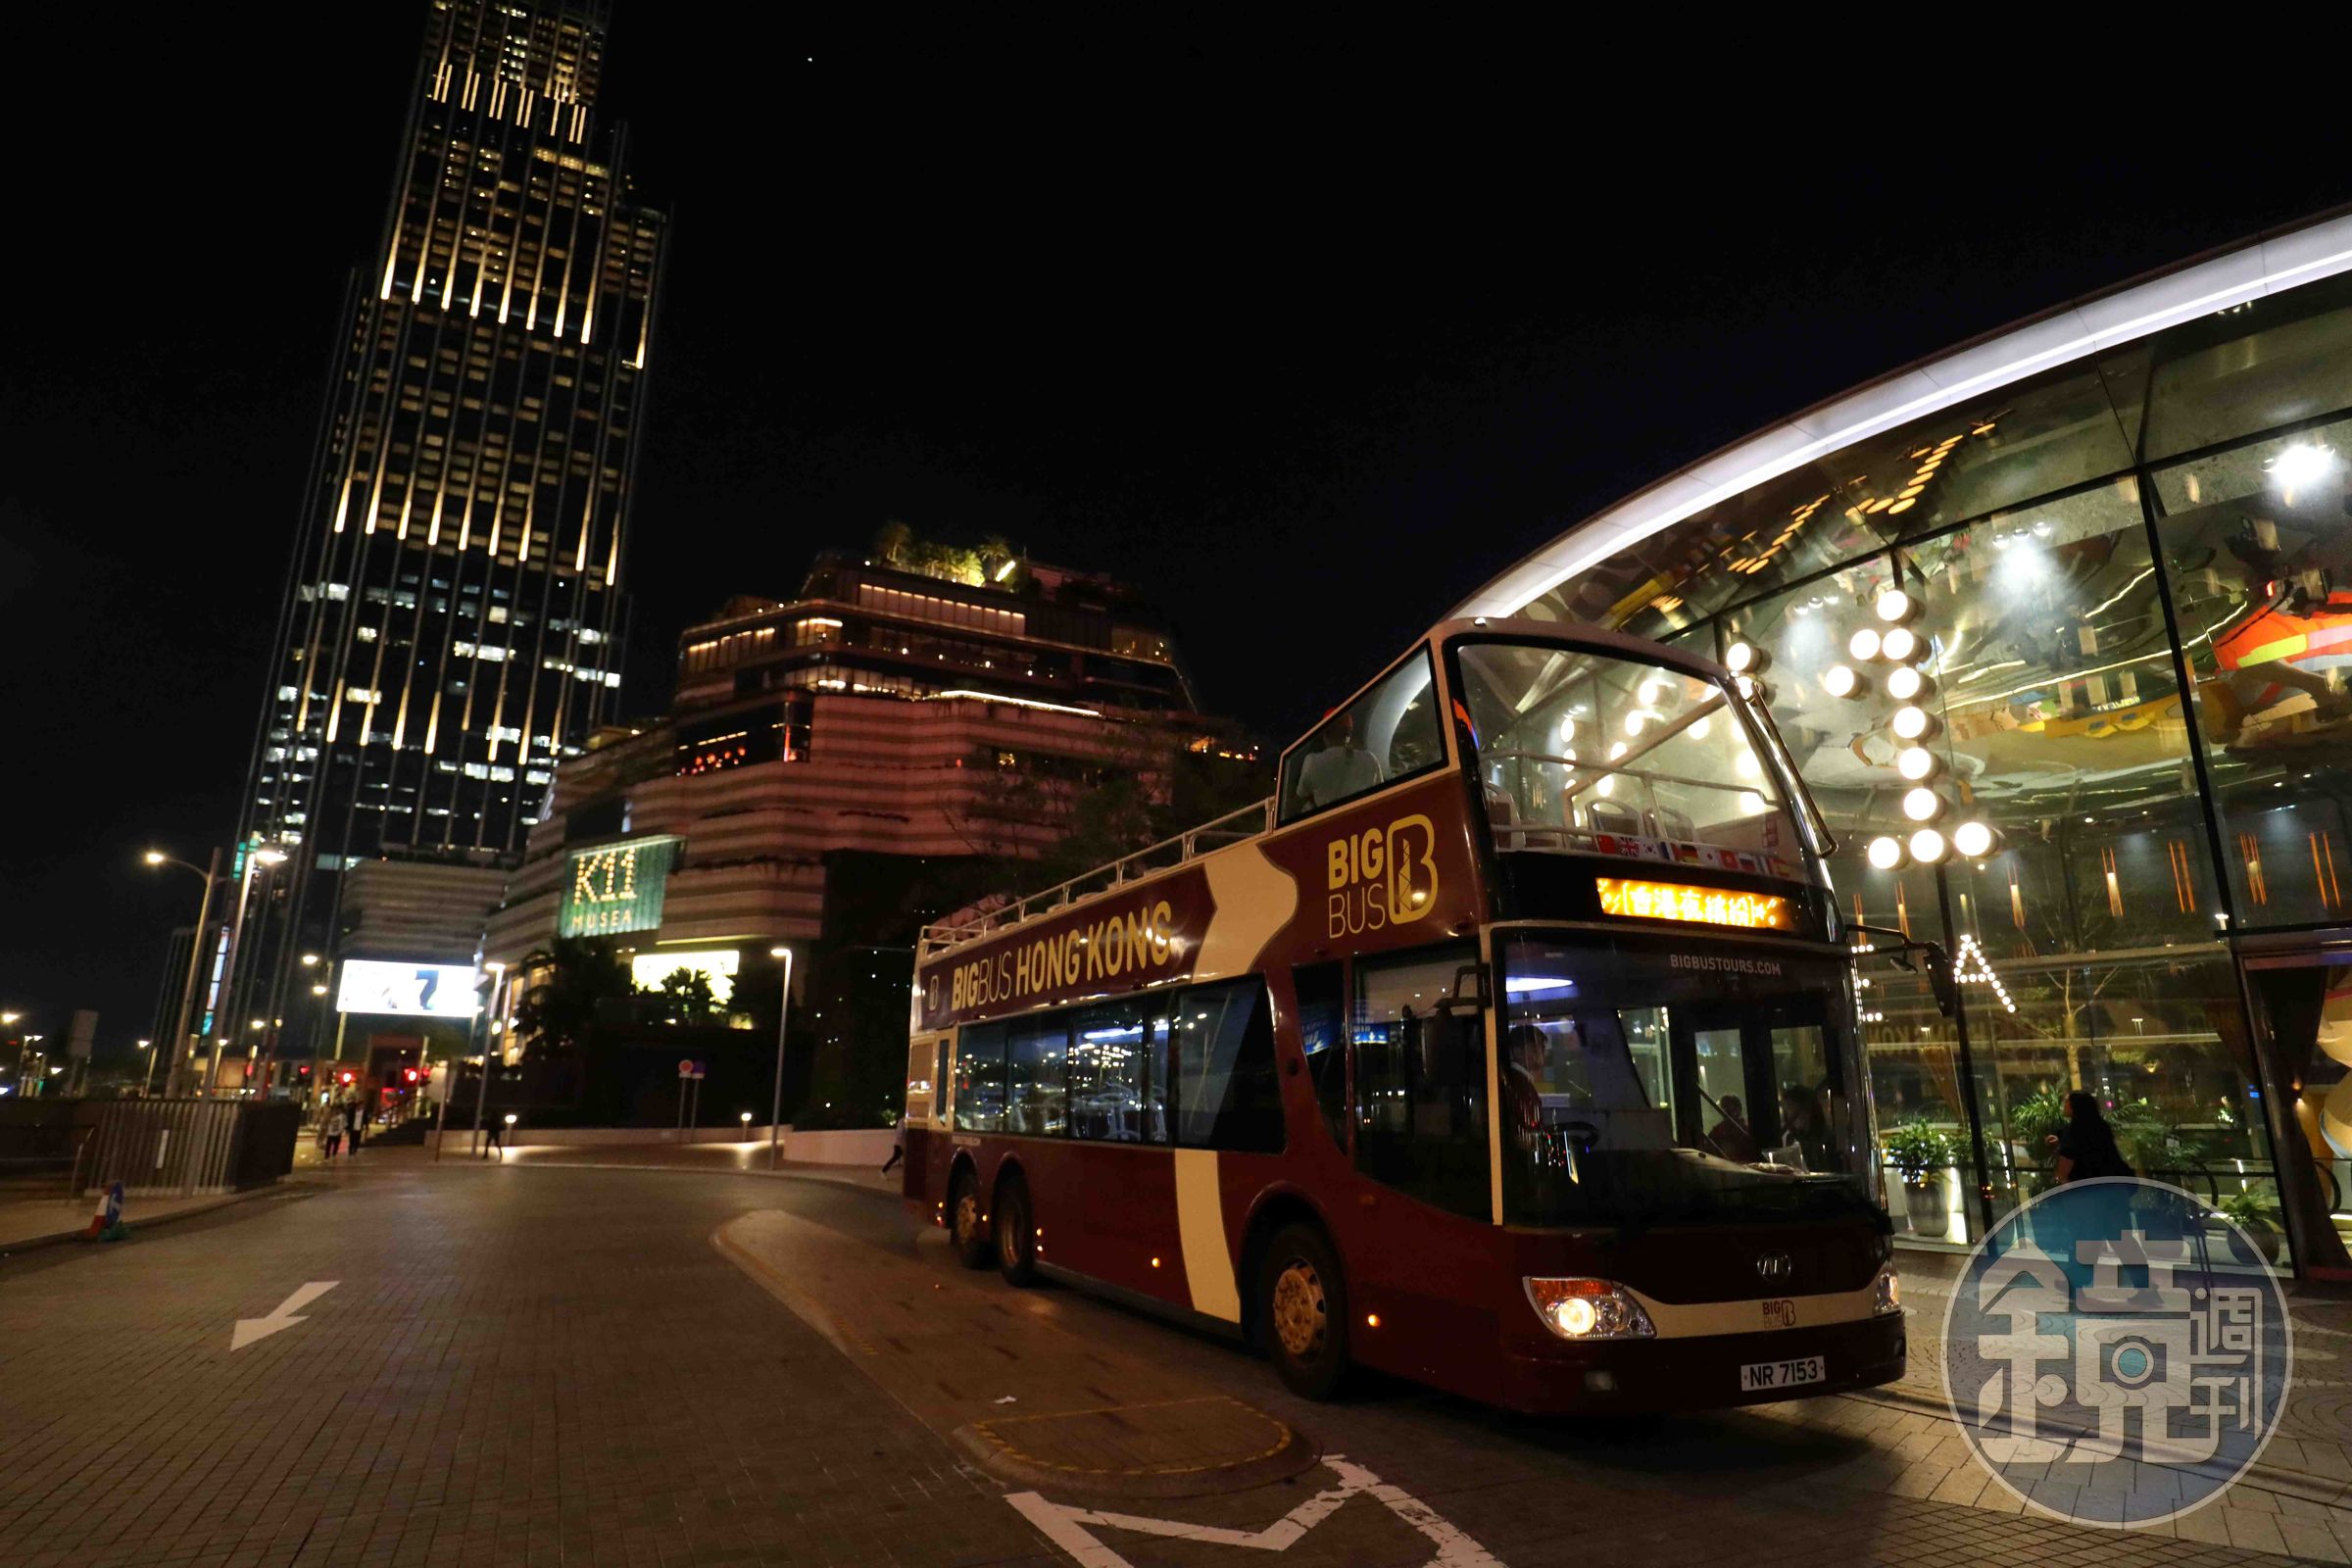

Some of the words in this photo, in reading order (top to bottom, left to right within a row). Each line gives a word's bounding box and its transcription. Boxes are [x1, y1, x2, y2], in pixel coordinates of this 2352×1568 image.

[1328, 827, 1384, 890] BIG
[573, 846, 638, 906] K11
[571, 908, 633, 931] MUSEA
[1328, 883, 1386, 939] BUS
[1016, 929, 1080, 997] HONG
[1086, 901, 1172, 981] KONG
[1670, 954, 1782, 976] BIGBUSTOURS.COM
[1762, 1300, 1781, 1315] BIG
[1763, 1315, 1784, 1329] BUS
[1749, 1365, 1774, 1387] NR
[1779, 1359, 1818, 1384] 7153
